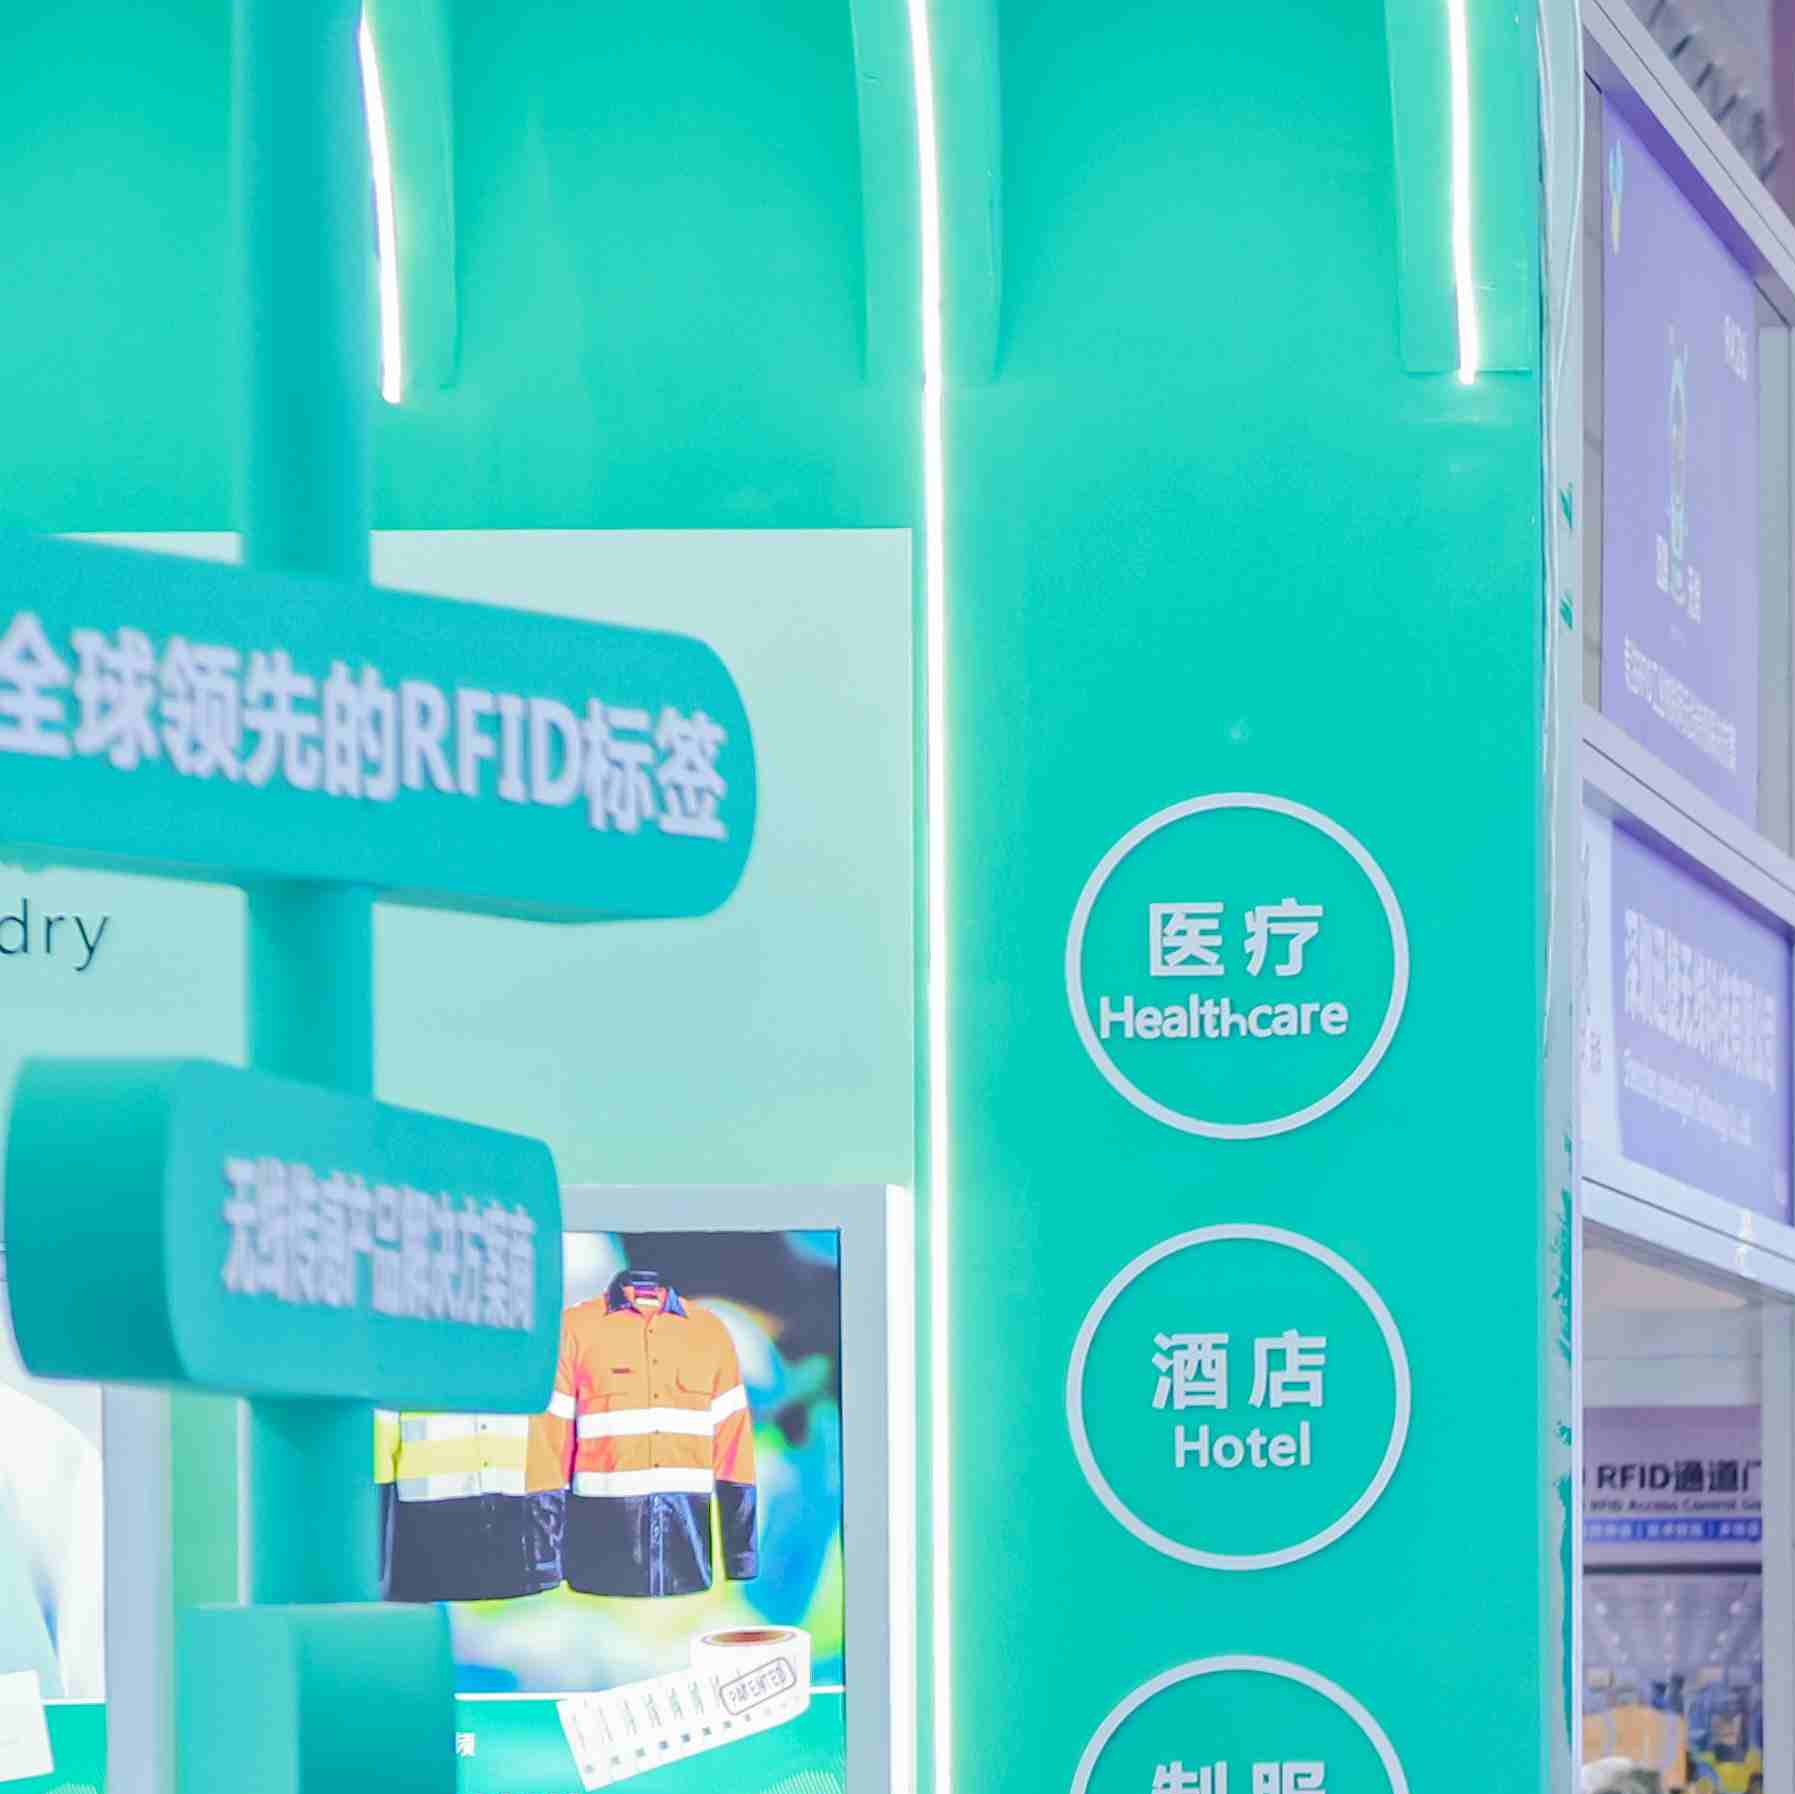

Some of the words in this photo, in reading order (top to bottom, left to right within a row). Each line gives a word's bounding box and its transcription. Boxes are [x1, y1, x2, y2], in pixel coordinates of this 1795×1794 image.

[0, 609, 728, 841] 全球领先的RFID标签
[1148, 896, 1324, 978] 医疗
[1099, 993, 1350, 1040] Healthcare
[1150, 1328, 1327, 1411] 酒店
[1173, 1421, 1313, 1469] Hotel
[727, 1664, 789, 1703] PATENTED
